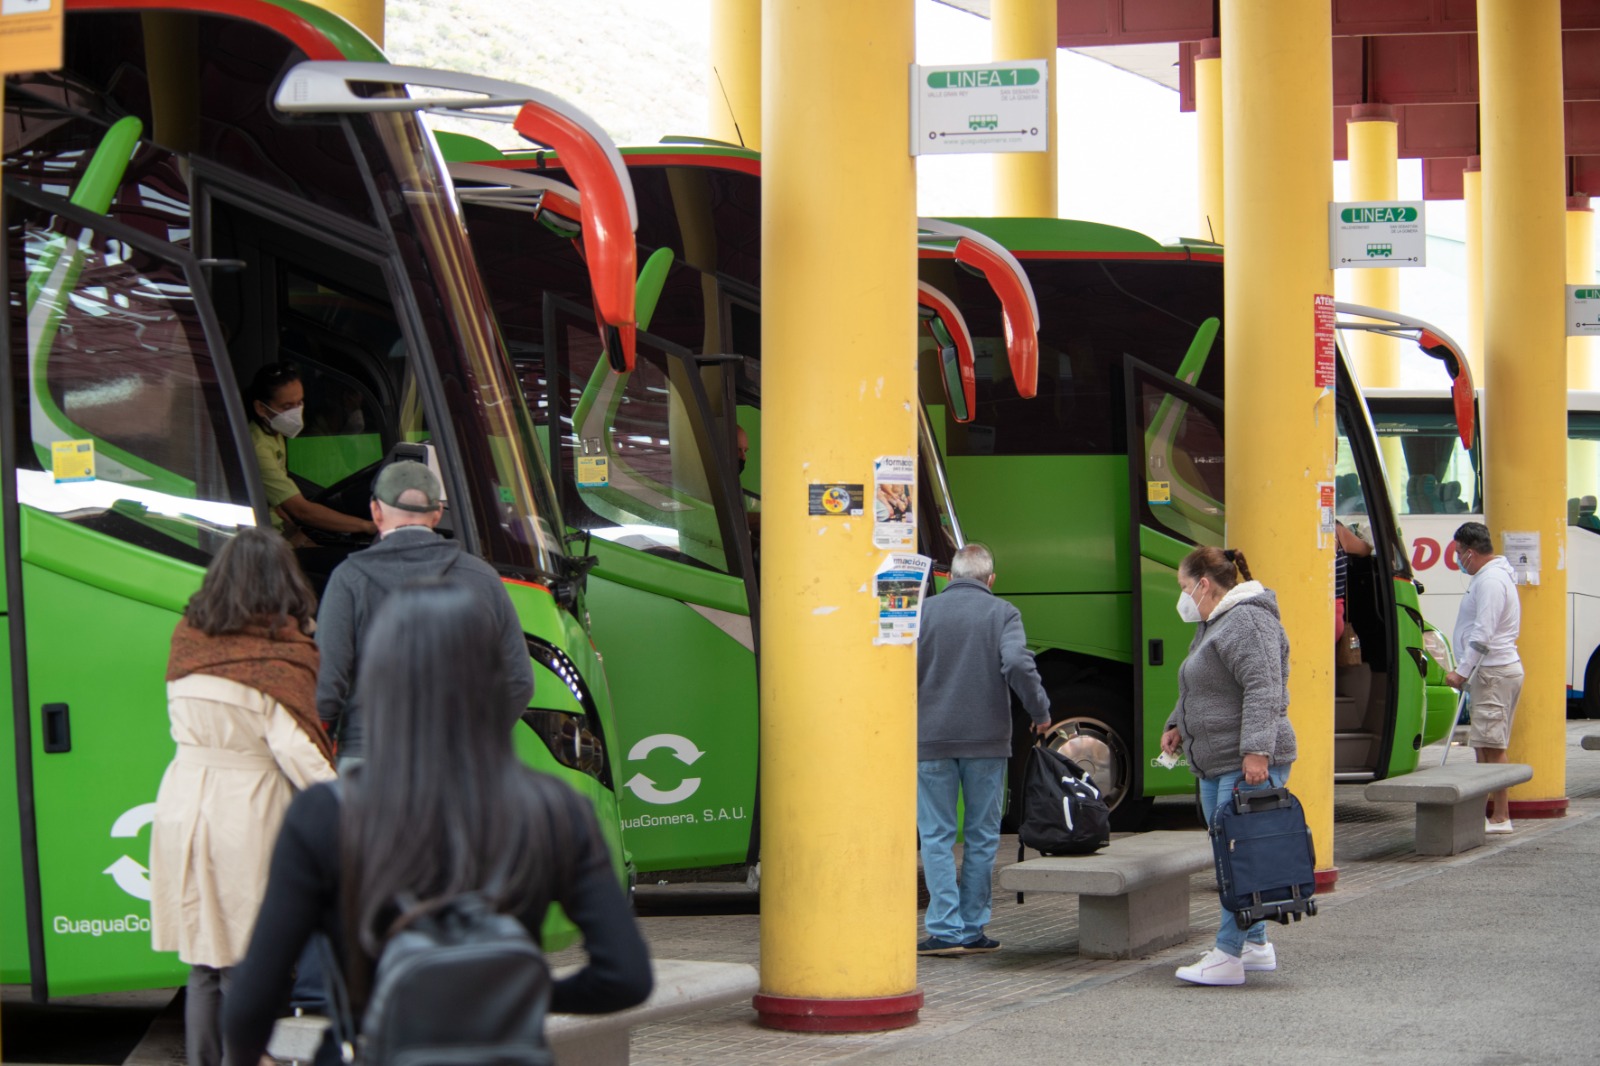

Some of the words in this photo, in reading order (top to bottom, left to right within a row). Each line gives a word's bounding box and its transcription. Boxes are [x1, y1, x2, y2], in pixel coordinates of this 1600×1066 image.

[946, 70, 1001, 88] LINEA
[1010, 70, 1018, 86] 1
[1352, 208, 1395, 223] LINEA
[1397, 208, 1406, 222] 2
[703, 806, 747, 822] S.A.U.
[53, 914, 151, 936] GuaguaGo
